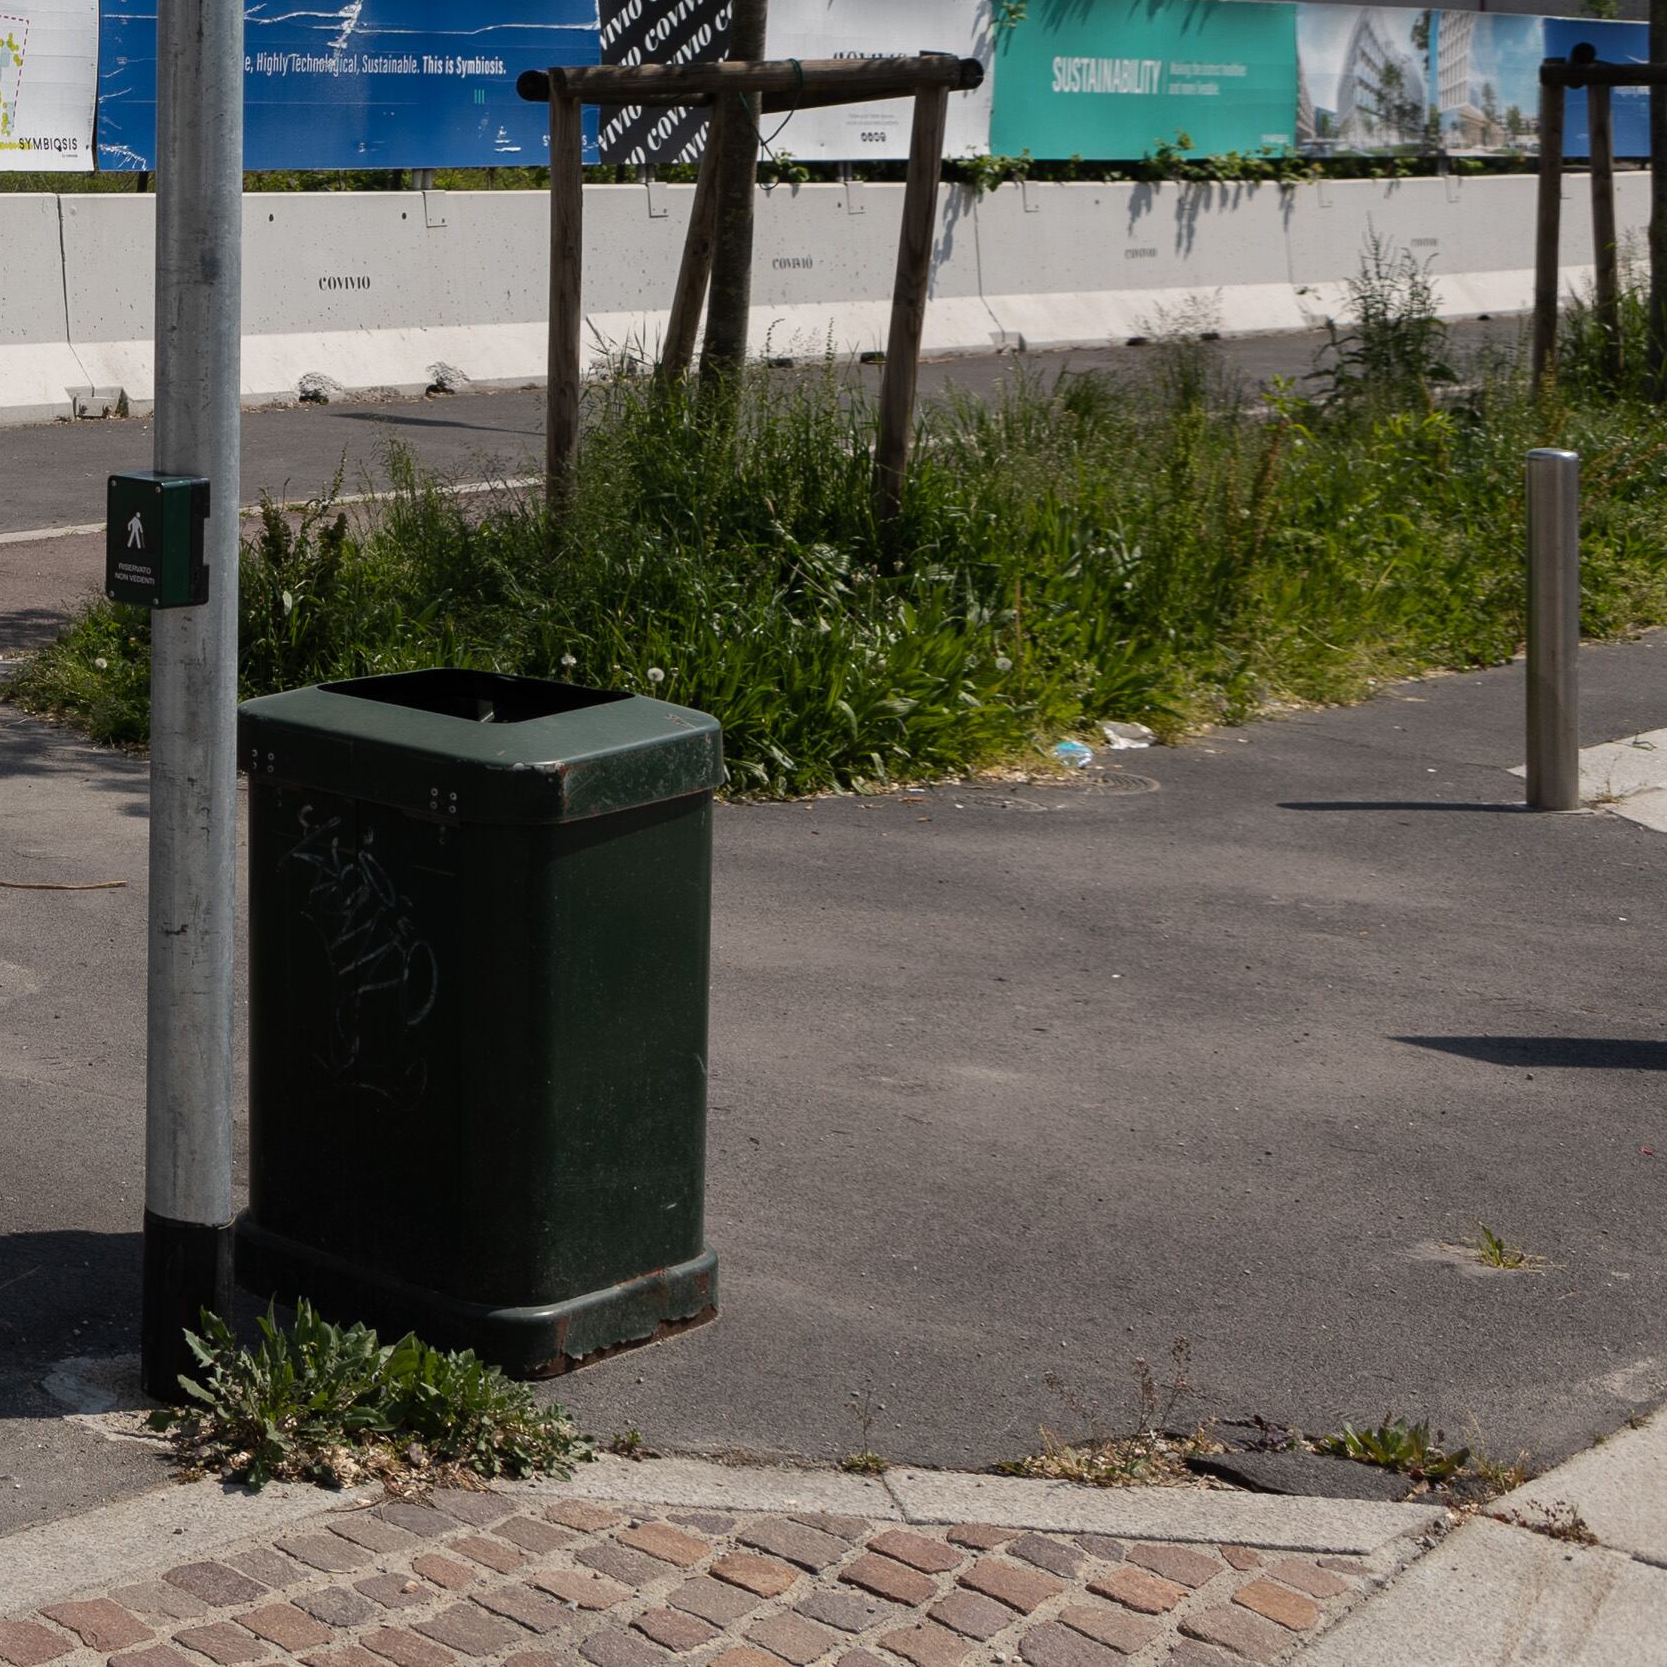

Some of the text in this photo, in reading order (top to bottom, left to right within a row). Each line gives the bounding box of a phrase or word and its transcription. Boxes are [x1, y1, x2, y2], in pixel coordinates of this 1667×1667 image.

[256, 52, 288, 77] Highly
[288, 53, 360, 78] Technological,
[362, 54, 420, 75] Sustainable.
[423, 55, 443, 75] This
[445, 55, 454, 75] is
[456, 55, 507, 78] Symbiosis.
[1051, 56, 1163, 95] SUSTAINABILITY
[18, 137, 79, 153] SYMBIOSIS
